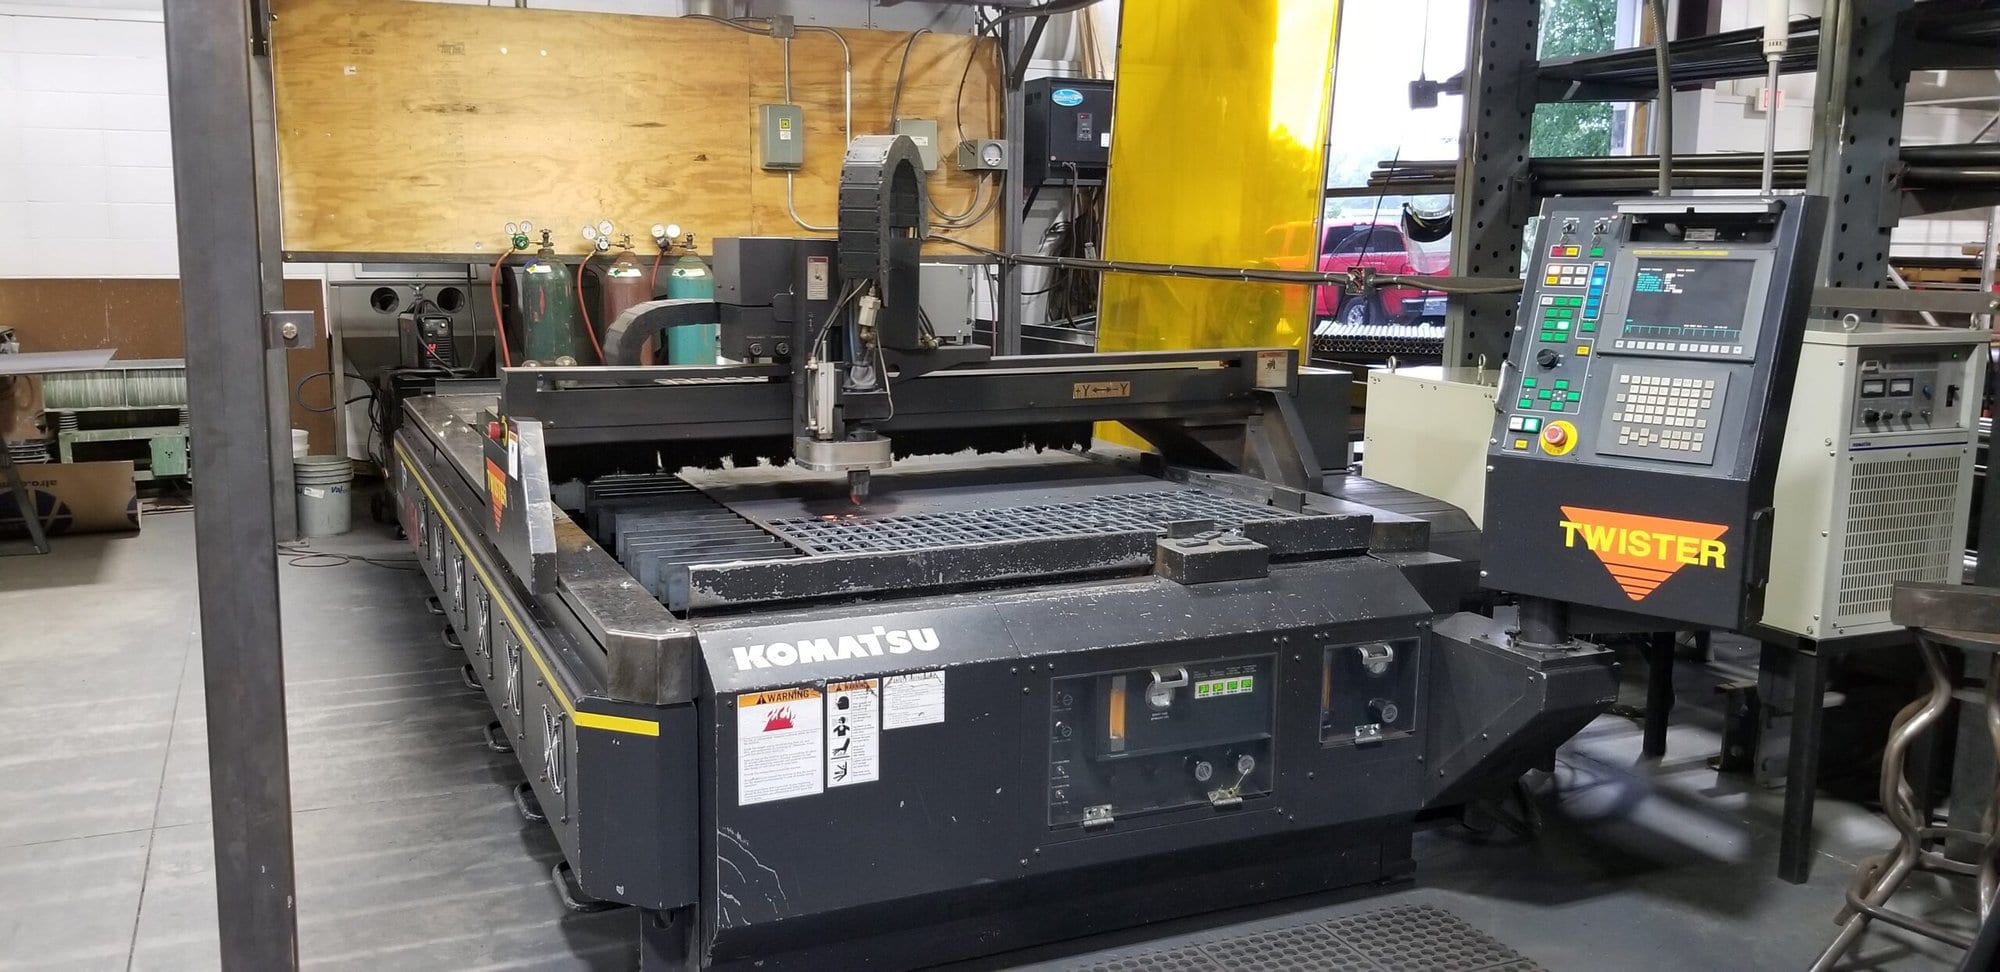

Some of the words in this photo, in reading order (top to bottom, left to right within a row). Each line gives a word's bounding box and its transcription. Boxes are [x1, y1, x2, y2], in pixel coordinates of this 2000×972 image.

[1559, 520, 1726, 569] TWISTER
[732, 625, 940, 671] KOMATSU
[768, 689, 809, 702] WARNING
